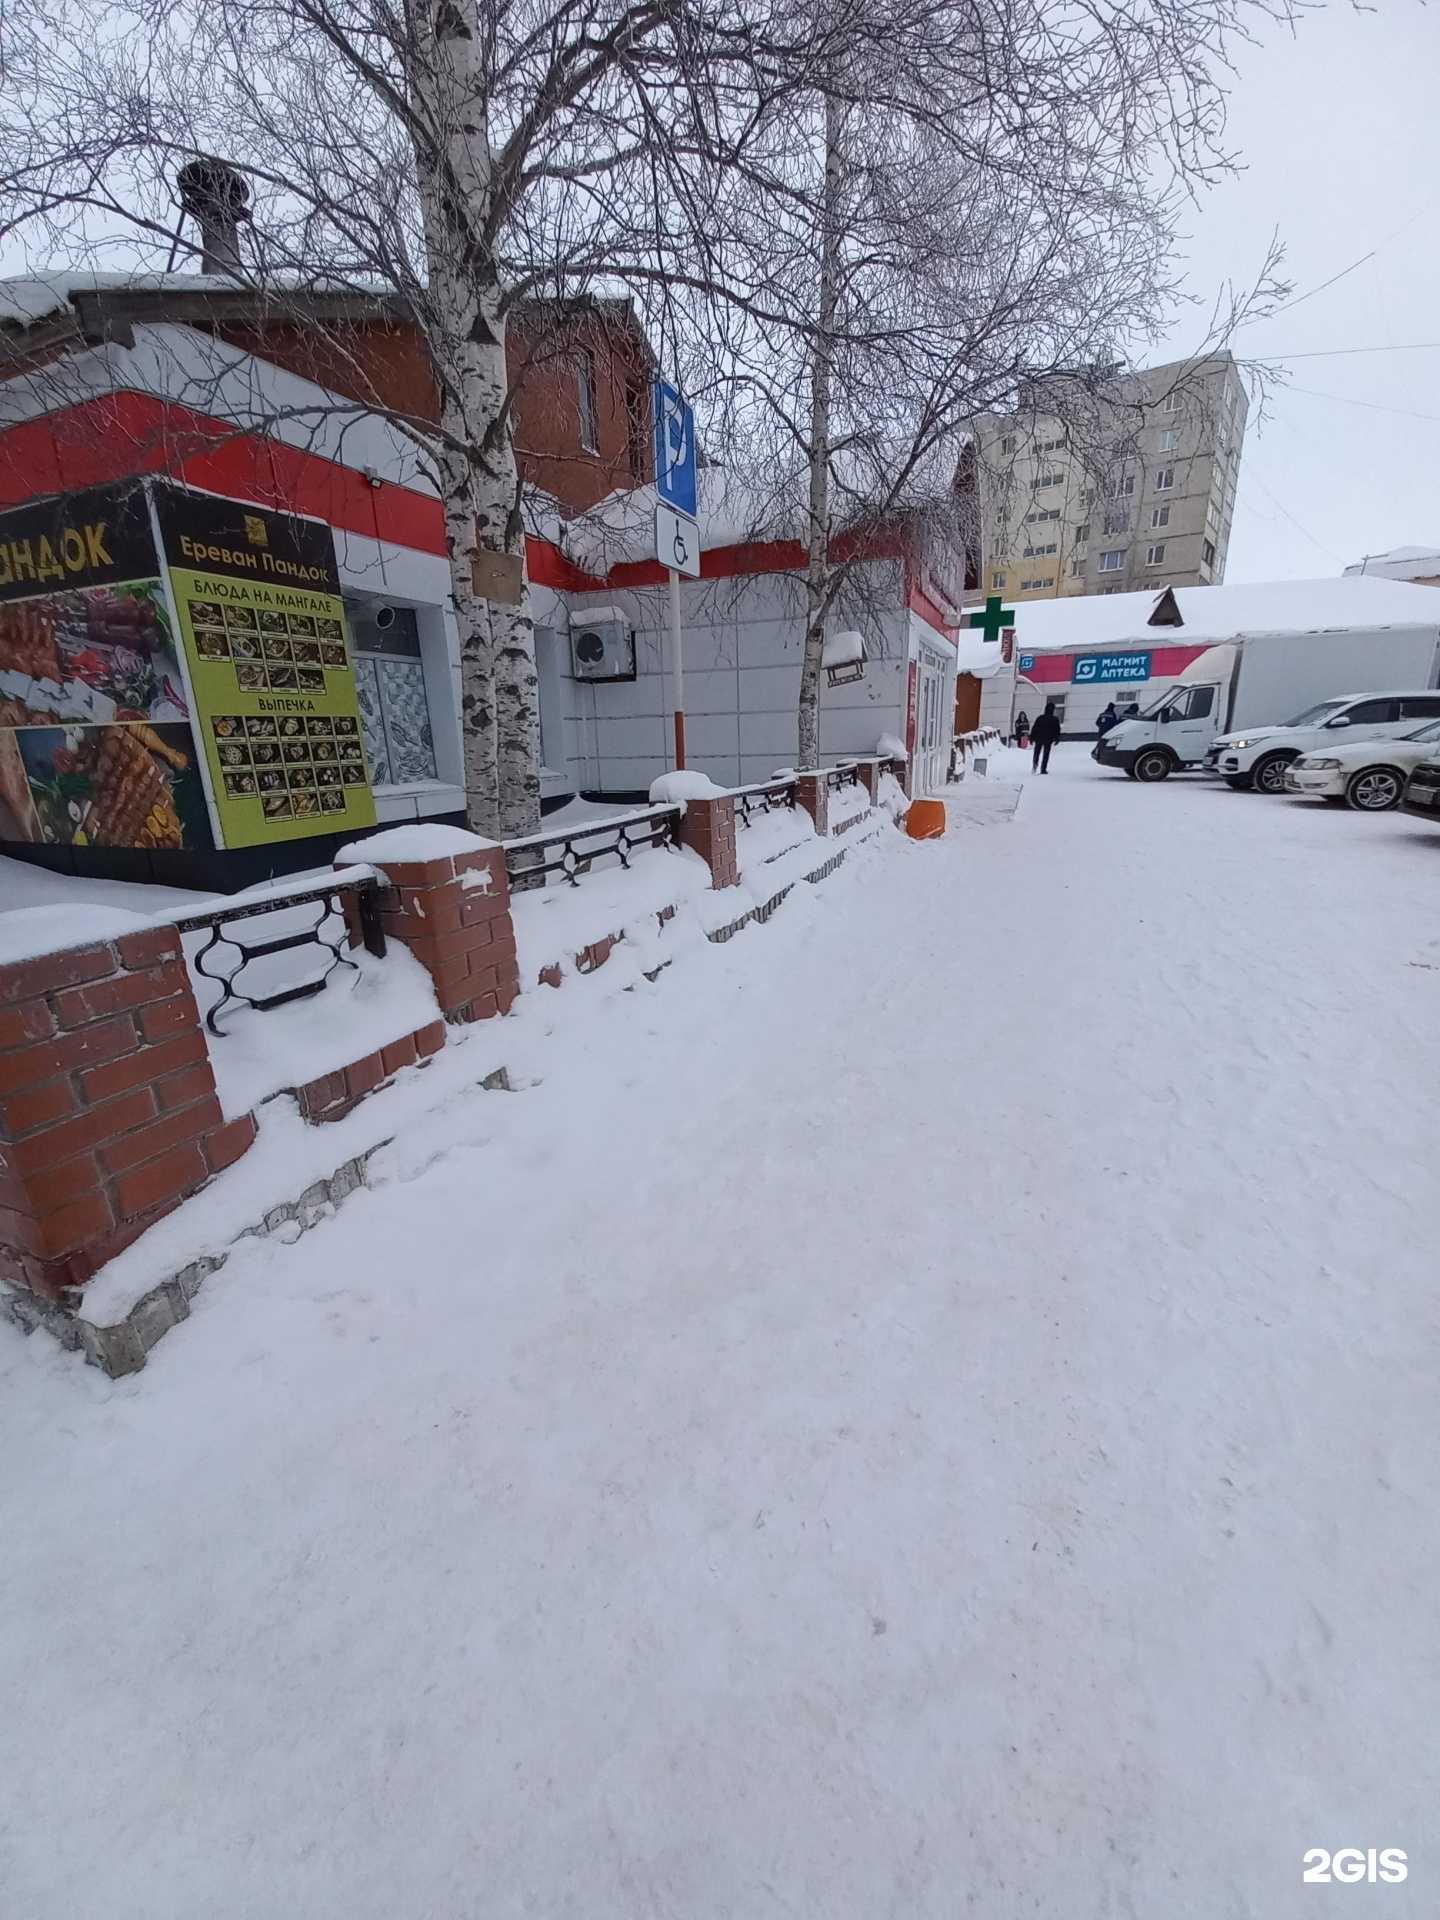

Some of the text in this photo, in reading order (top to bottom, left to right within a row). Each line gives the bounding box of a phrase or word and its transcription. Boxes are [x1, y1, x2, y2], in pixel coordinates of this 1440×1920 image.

[663, 393, 687, 491] P
[180, 535, 329, 583] Ереван Пандок
[194, 579, 332, 613] БЛЮДА НА МАНГАЛЕ
[1101, 656, 1147, 668] МАГНИТ
[1101, 667, 1146, 678] АПТЕКА
[258, 698, 316, 712] ВЫПЕЧКА
